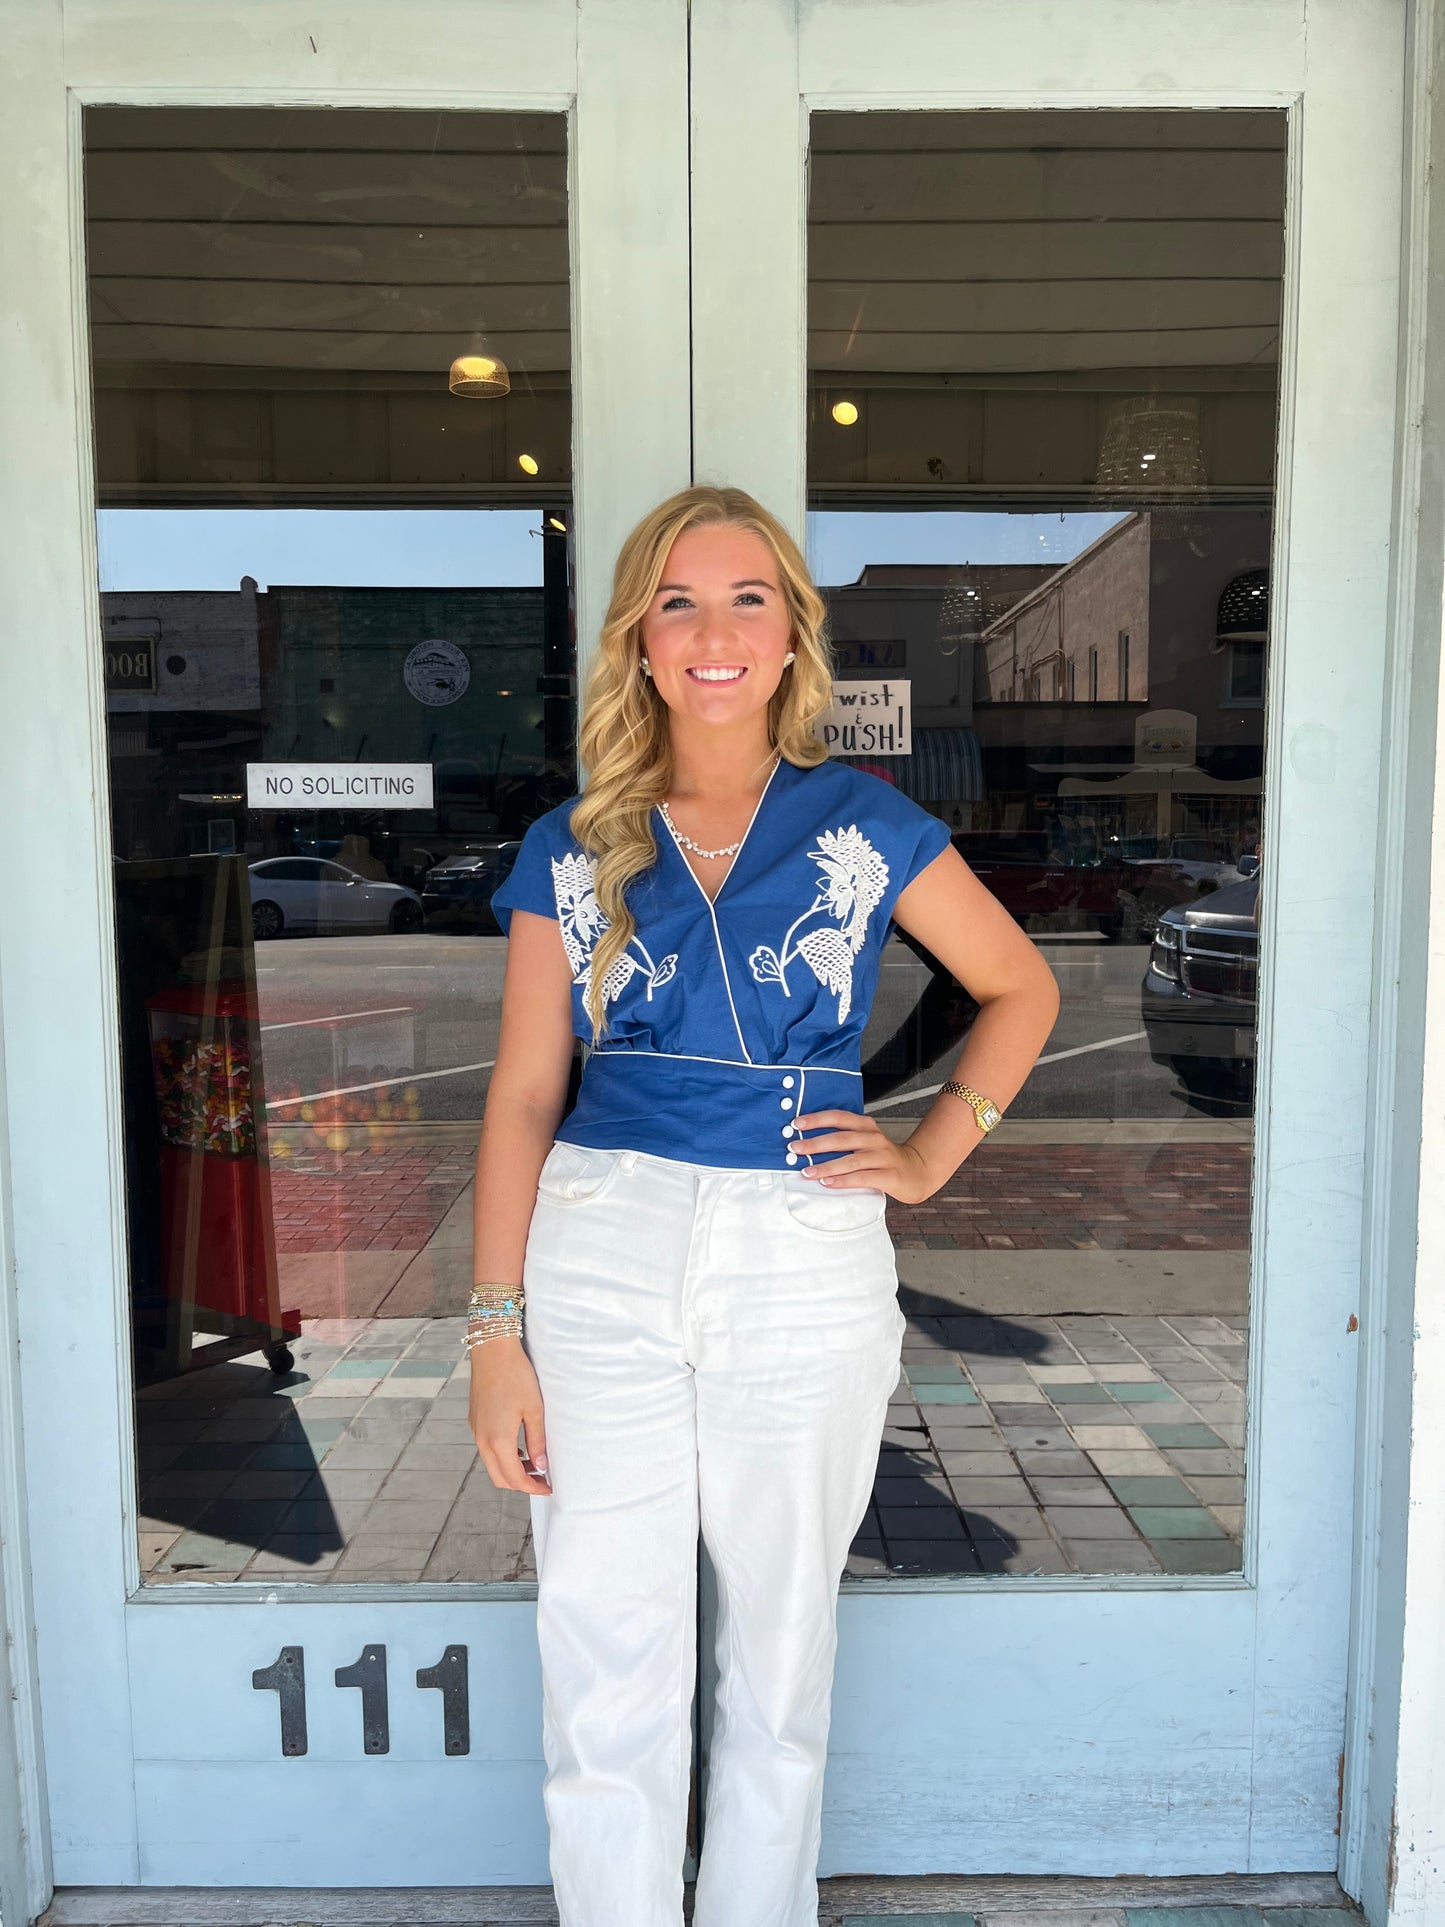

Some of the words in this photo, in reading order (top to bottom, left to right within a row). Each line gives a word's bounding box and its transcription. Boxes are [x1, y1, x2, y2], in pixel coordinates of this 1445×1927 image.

[833, 684, 893, 706] wist
[824, 706, 903, 751] PUSH!
[266, 777, 293, 794] NO
[302, 777, 414, 794] SOLICITING
[252, 1644, 470, 1757] 111
